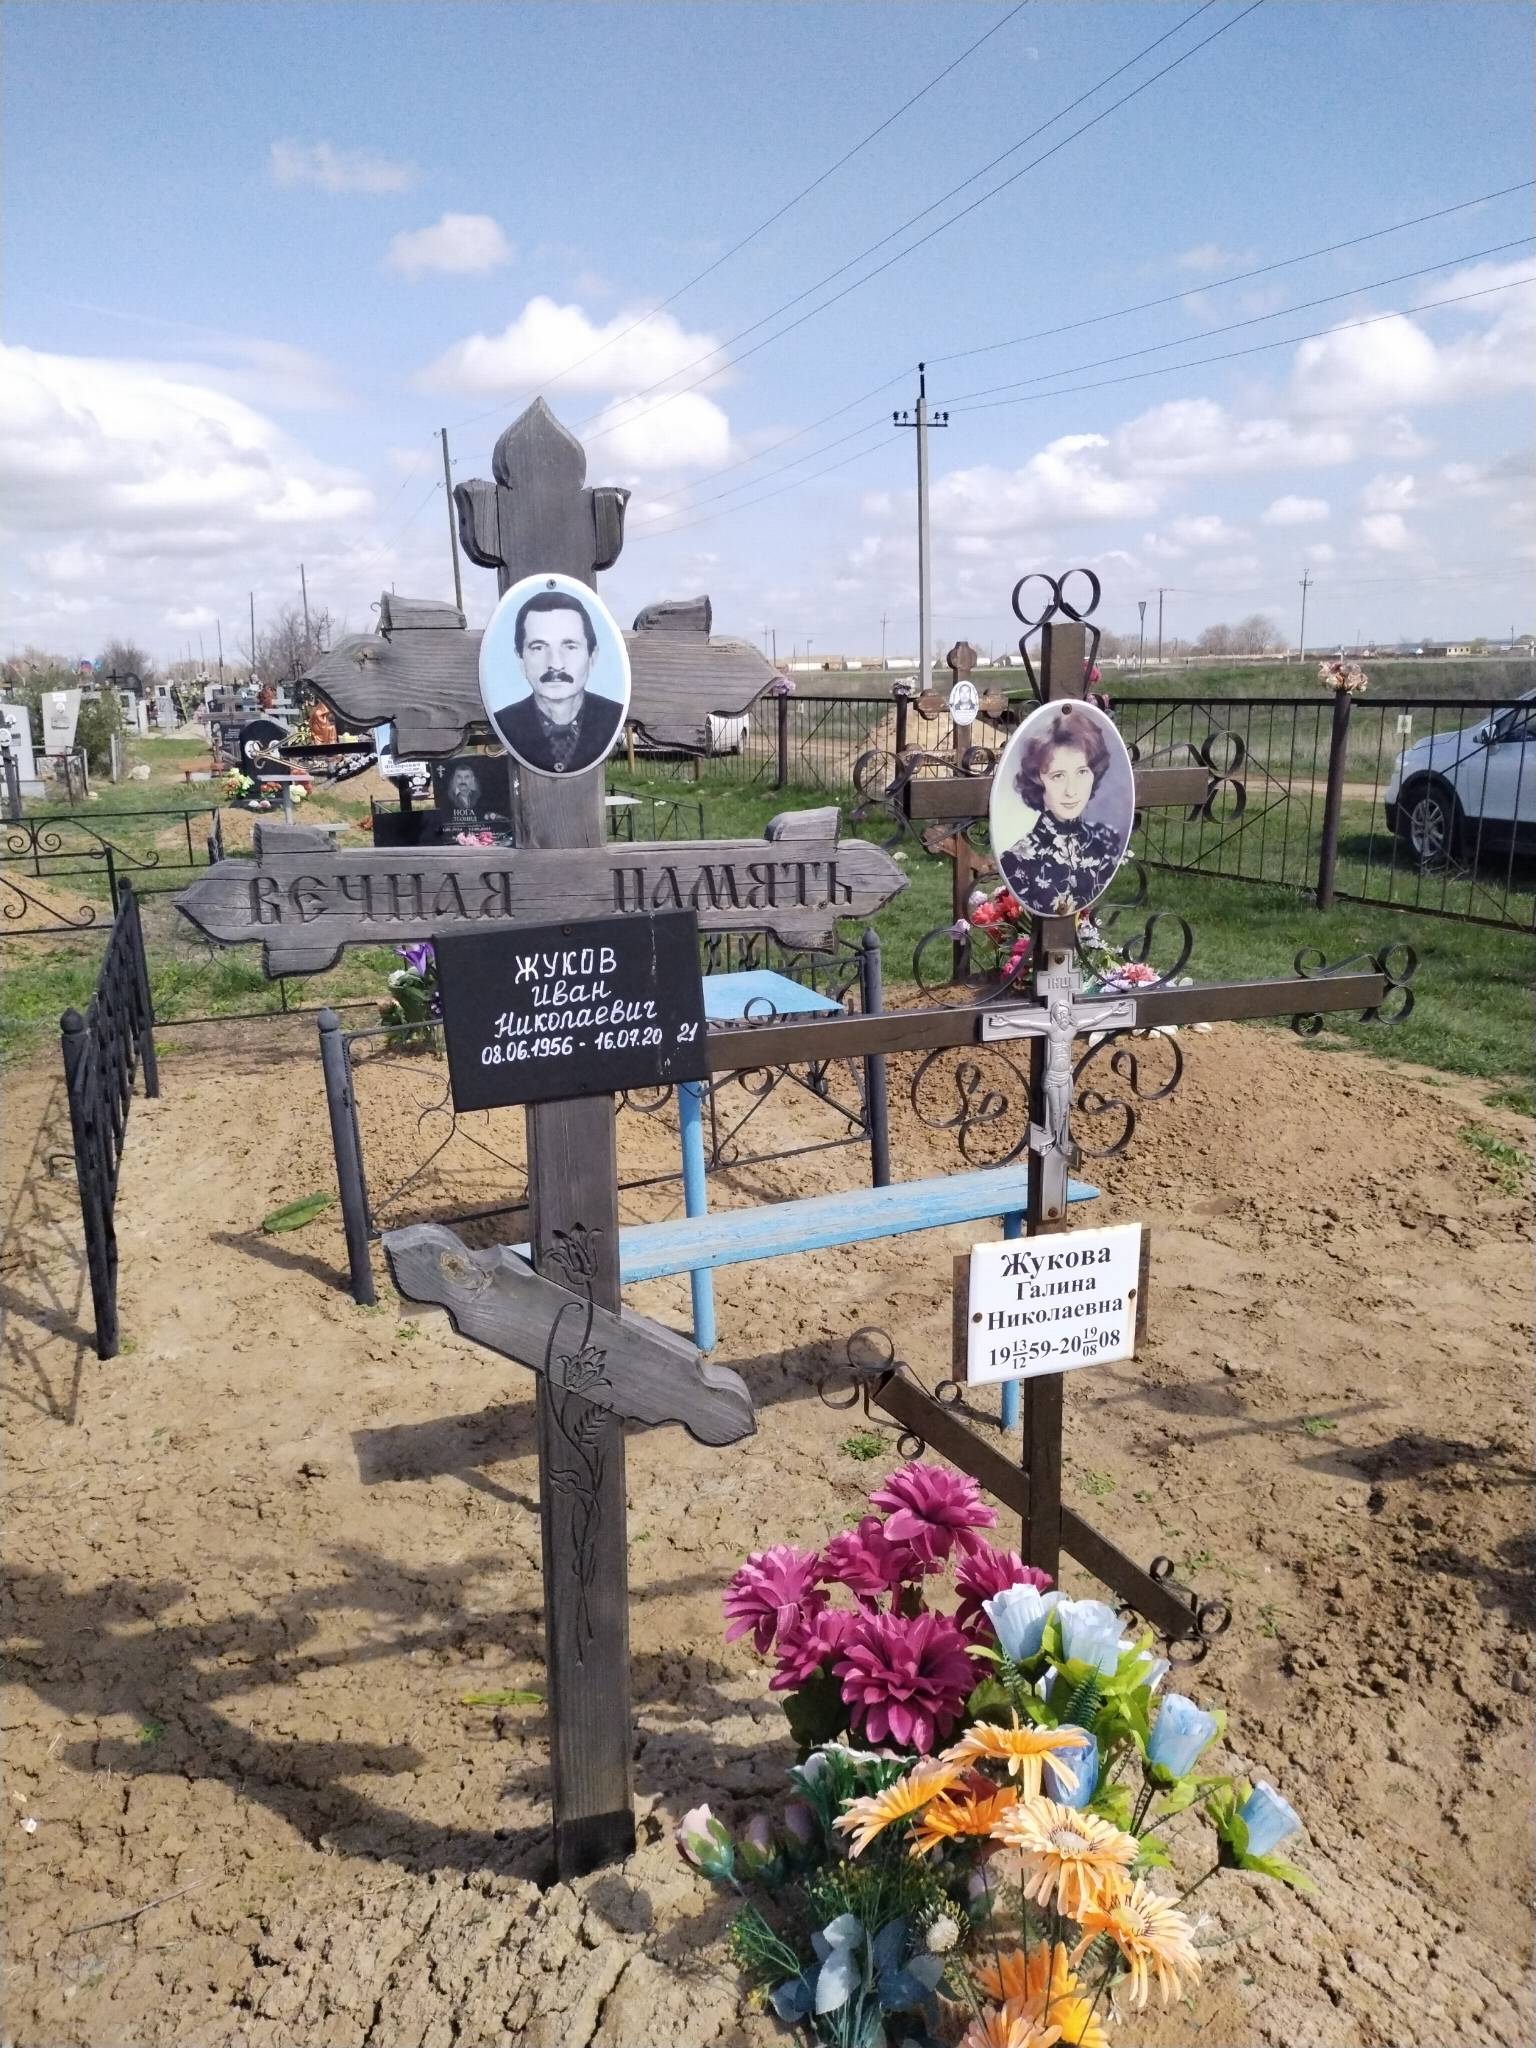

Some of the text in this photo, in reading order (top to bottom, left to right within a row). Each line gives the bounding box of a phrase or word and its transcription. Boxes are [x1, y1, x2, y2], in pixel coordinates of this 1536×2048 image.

[609, 861, 852, 912] ПАМЯТЬ
[515, 947, 617, 984] ЖУКОВ
[531, 980, 612, 1007] Иван
[494, 1000, 657, 1038] Николаевич
[481, 1036, 574, 1065] 08.06.1956
[677, 1022, 698, 1044] 21
[1000, 1247, 1111, 1279] Жукова
[1016, 1277, 1096, 1301] Галина
[988, 1298, 1123, 1330] Николаевна
